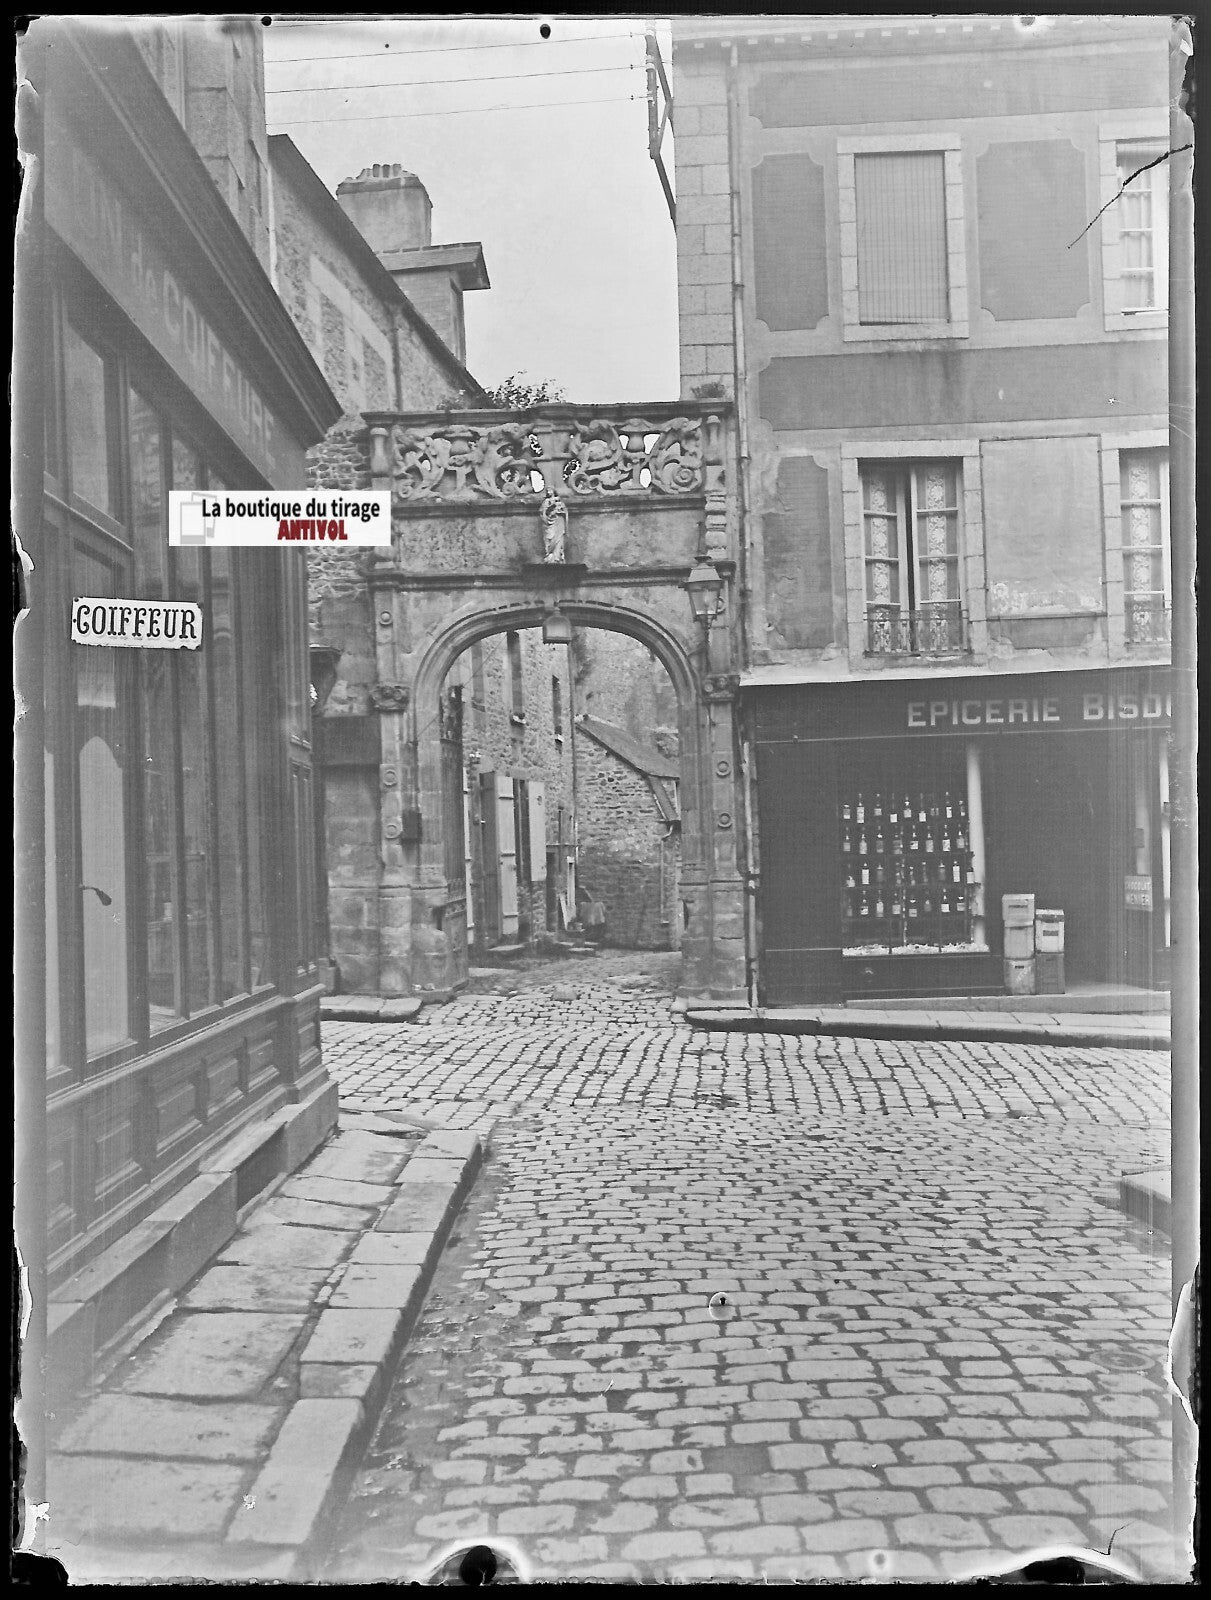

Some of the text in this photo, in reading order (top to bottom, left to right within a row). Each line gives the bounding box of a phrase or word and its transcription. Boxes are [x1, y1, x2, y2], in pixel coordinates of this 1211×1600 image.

[163, 270, 276, 470] COIFFURE
[77, 605, 196, 639] COIFFEUR
[907, 698, 1060, 726] EPICERIE
